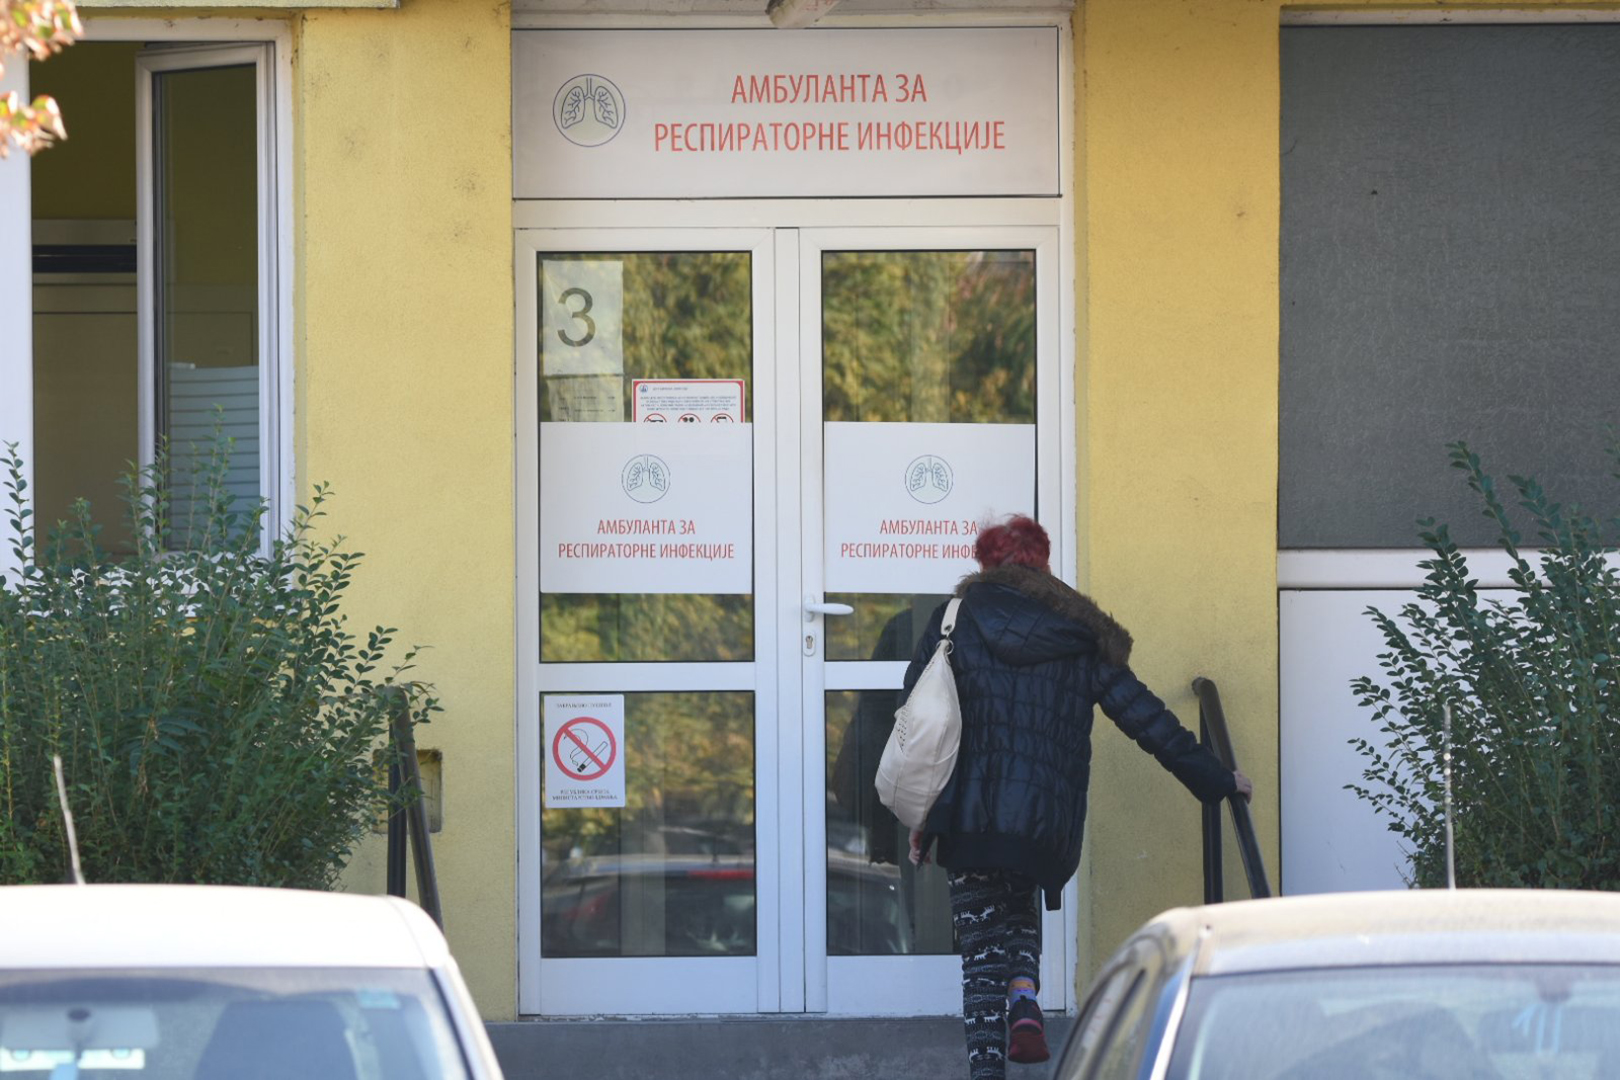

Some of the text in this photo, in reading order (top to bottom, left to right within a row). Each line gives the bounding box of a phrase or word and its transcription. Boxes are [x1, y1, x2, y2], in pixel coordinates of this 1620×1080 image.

[732, 73, 928, 104] АМБУЛАНТА ЗА
[655, 120, 1006, 155] РЕСПИРАТОРНЕ ИНФЕКЦИЈЕ
[557, 287, 596, 347] 3
[597, 519, 696, 535] АМБУЛАНТА ЗА
[879, 519, 978, 535] АМБУЛАНТА ЗА
[558, 543, 734, 561] РЕСПИРАТОРНЕ ИНФЕКЦИЈЕ
[841, 543, 938, 558] РЕСПИРАТОРНЕ
